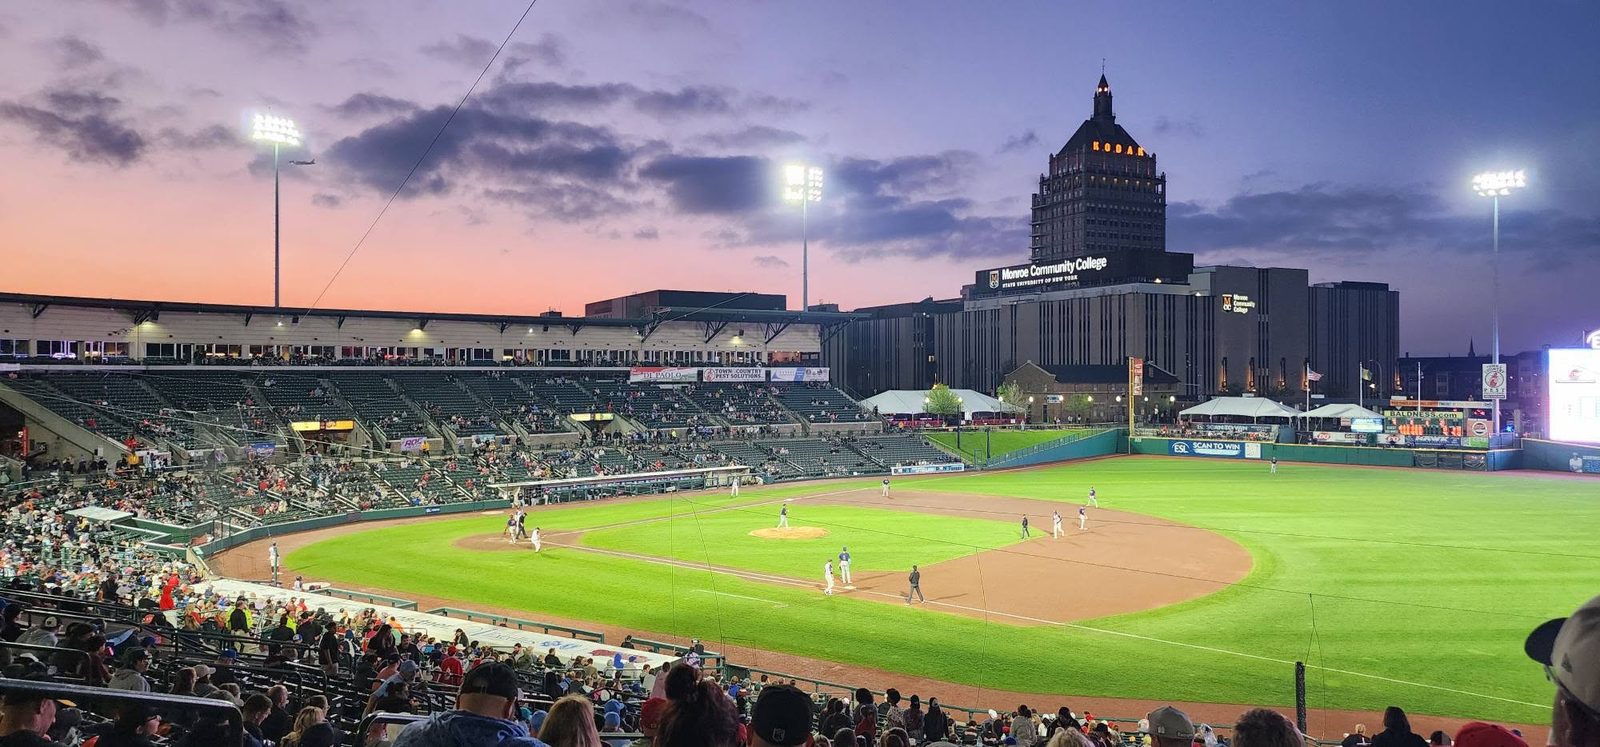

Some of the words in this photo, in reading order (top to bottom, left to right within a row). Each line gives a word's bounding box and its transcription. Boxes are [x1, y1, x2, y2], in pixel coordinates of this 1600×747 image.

[1093, 141, 1144, 156] KODAK
[1002, 268, 1029, 280] Monroe
[1030, 260, 1075, 275] Community
[1075, 256, 1107, 271] College
[1016, 279, 1044, 287] UNIVERSITY
[1174, 444, 1189, 453] ESL
[1192, 441, 1213, 449] SCAN
